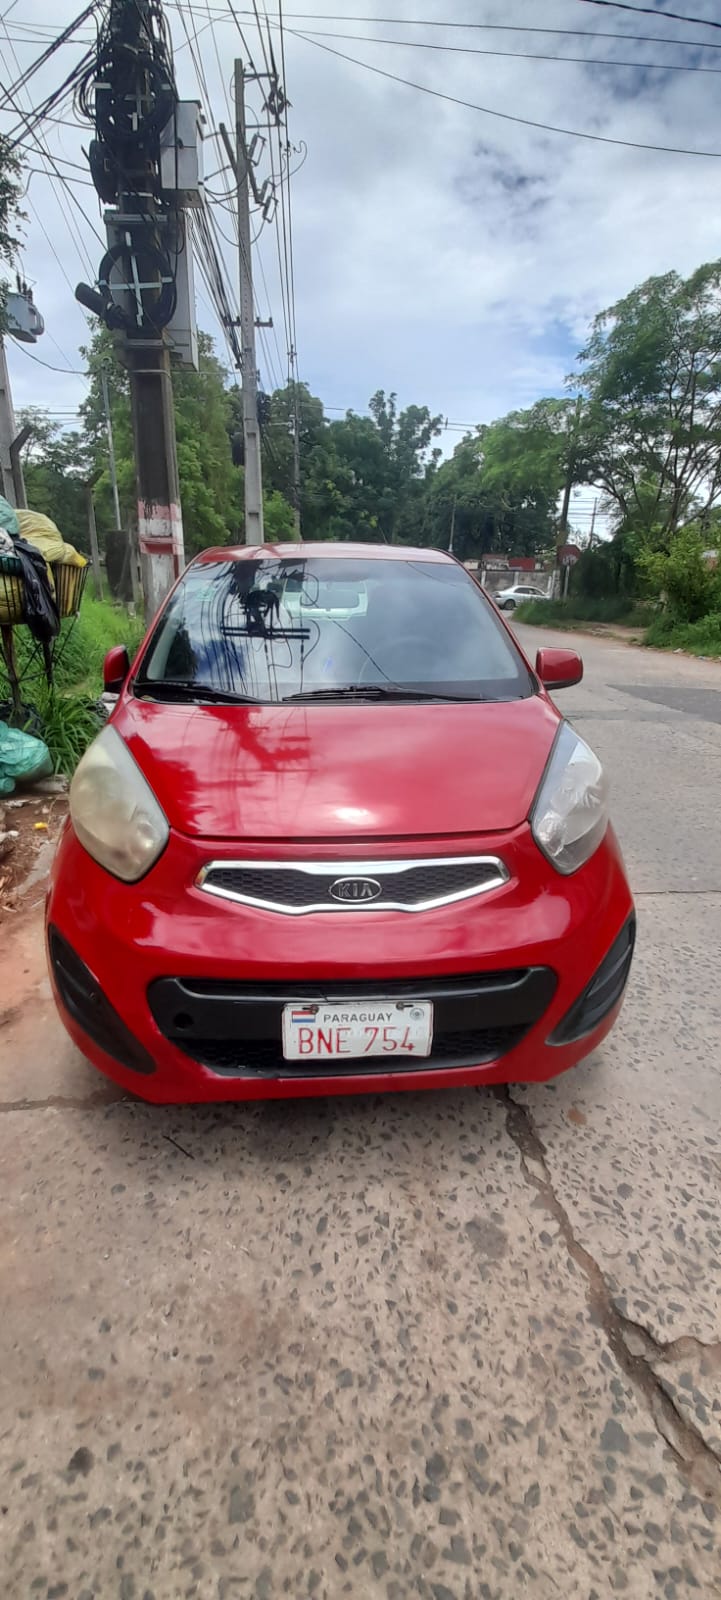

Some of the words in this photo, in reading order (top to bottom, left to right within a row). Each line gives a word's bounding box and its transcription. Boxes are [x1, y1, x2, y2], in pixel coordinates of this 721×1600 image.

[338, 882, 373, 897] KIA
[323, 1012, 393, 1023] PARAGUAY
[298, 1027, 351, 1054] BNE
[363, 1026, 415, 1052] 754
